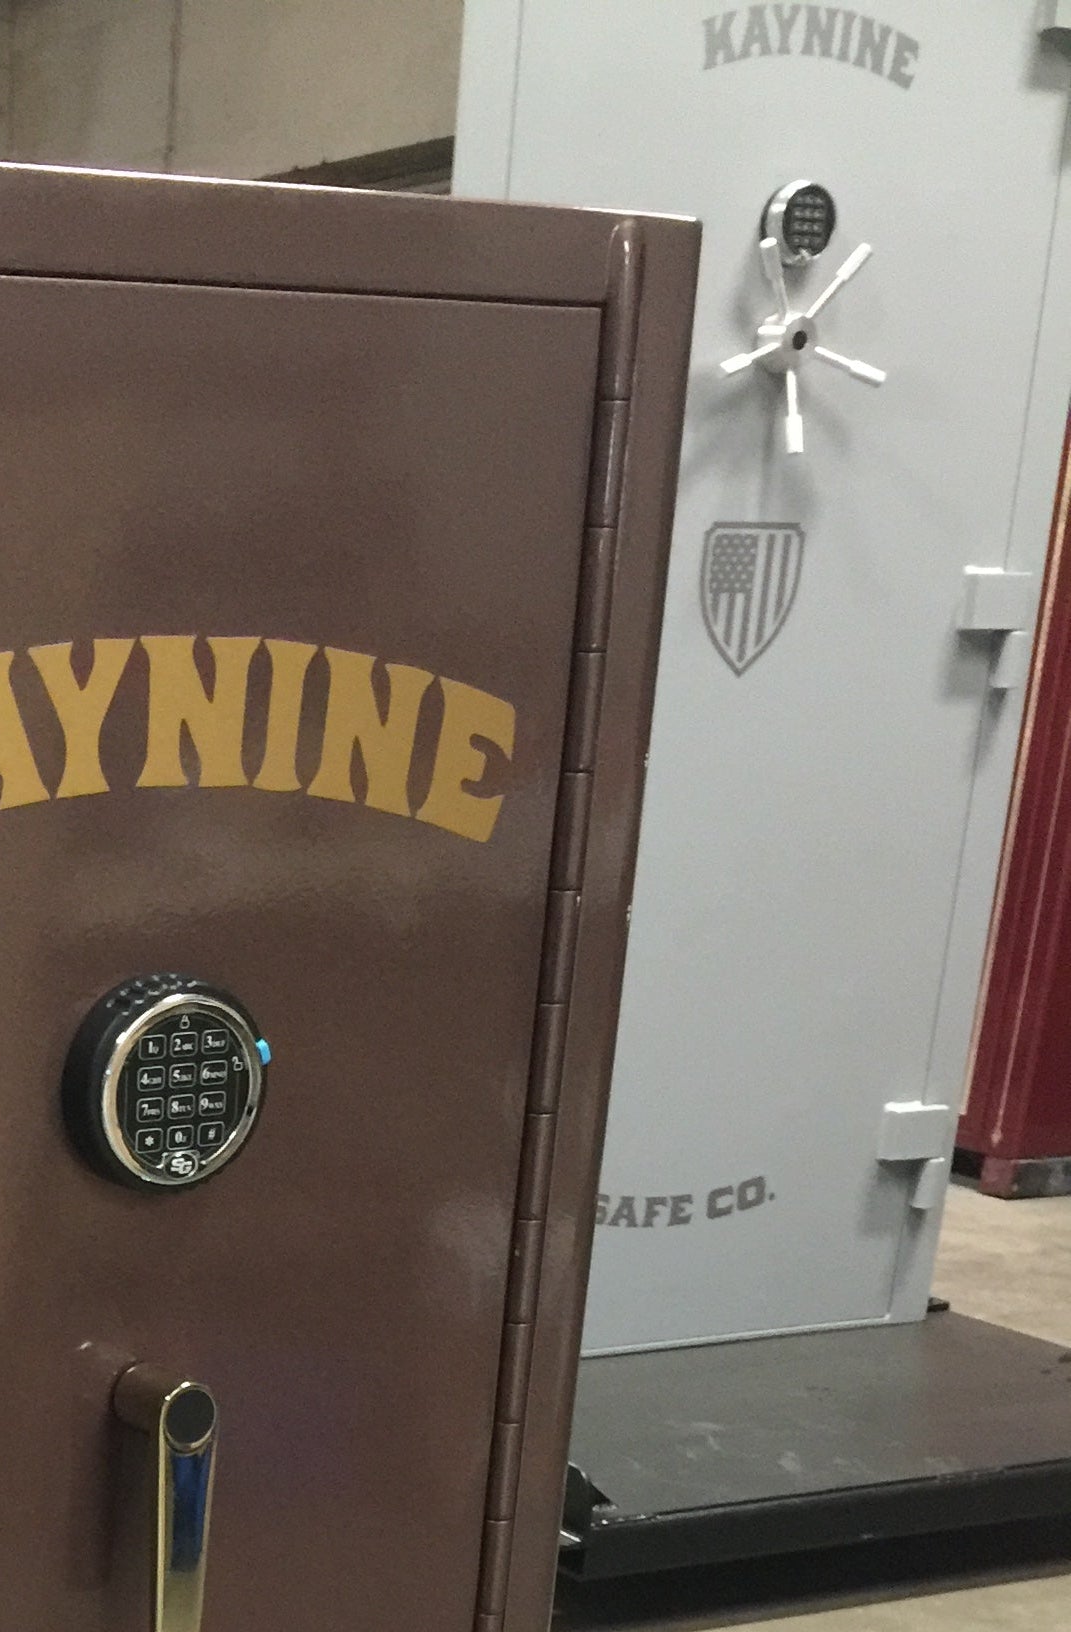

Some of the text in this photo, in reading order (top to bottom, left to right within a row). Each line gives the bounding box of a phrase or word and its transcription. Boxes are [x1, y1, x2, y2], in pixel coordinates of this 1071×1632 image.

[702, 5, 920, 90] KAYNINE
[595, 1175, 776, 1227] SAFE CO.
